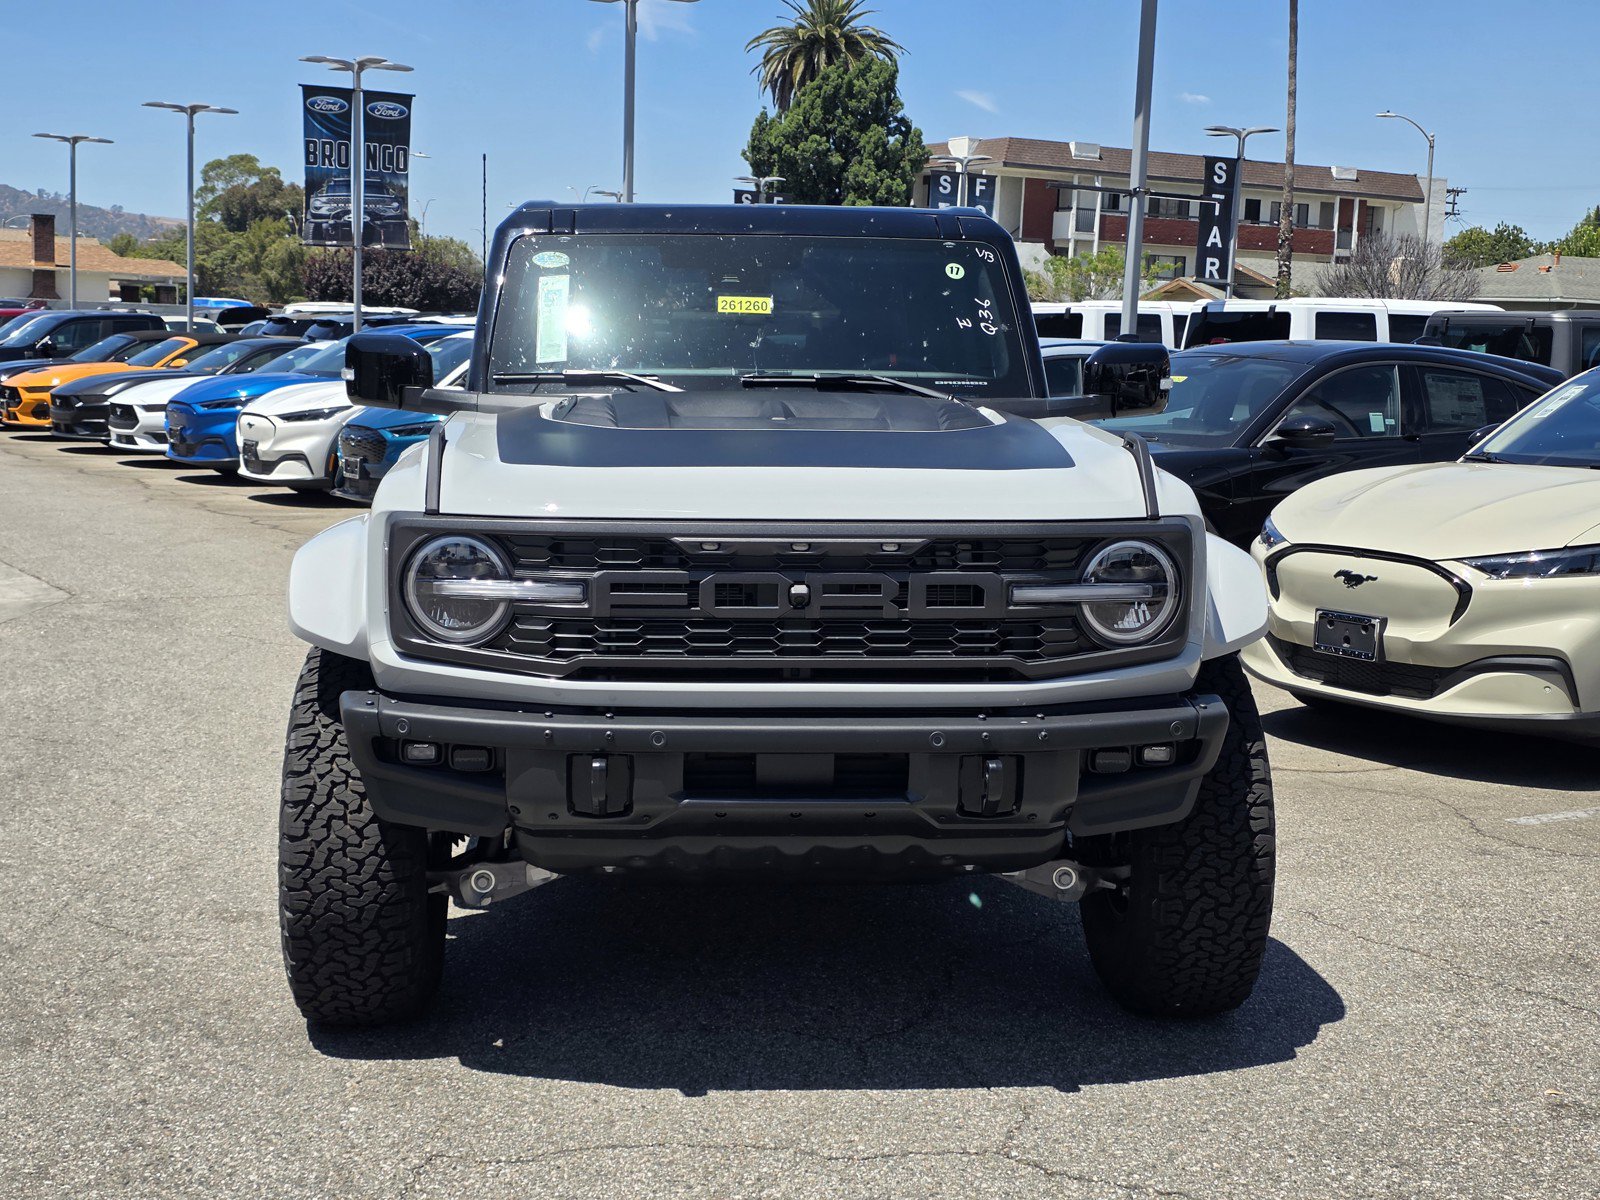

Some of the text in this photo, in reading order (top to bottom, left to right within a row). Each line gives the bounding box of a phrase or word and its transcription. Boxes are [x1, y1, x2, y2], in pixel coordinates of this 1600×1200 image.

[314, 98, 340, 112] Ford
[374, 104, 400, 117] Ford
[949, 266, 960, 276] 17
[721, 299, 768, 311] 261260
[597, 571, 1002, 619] FORD
